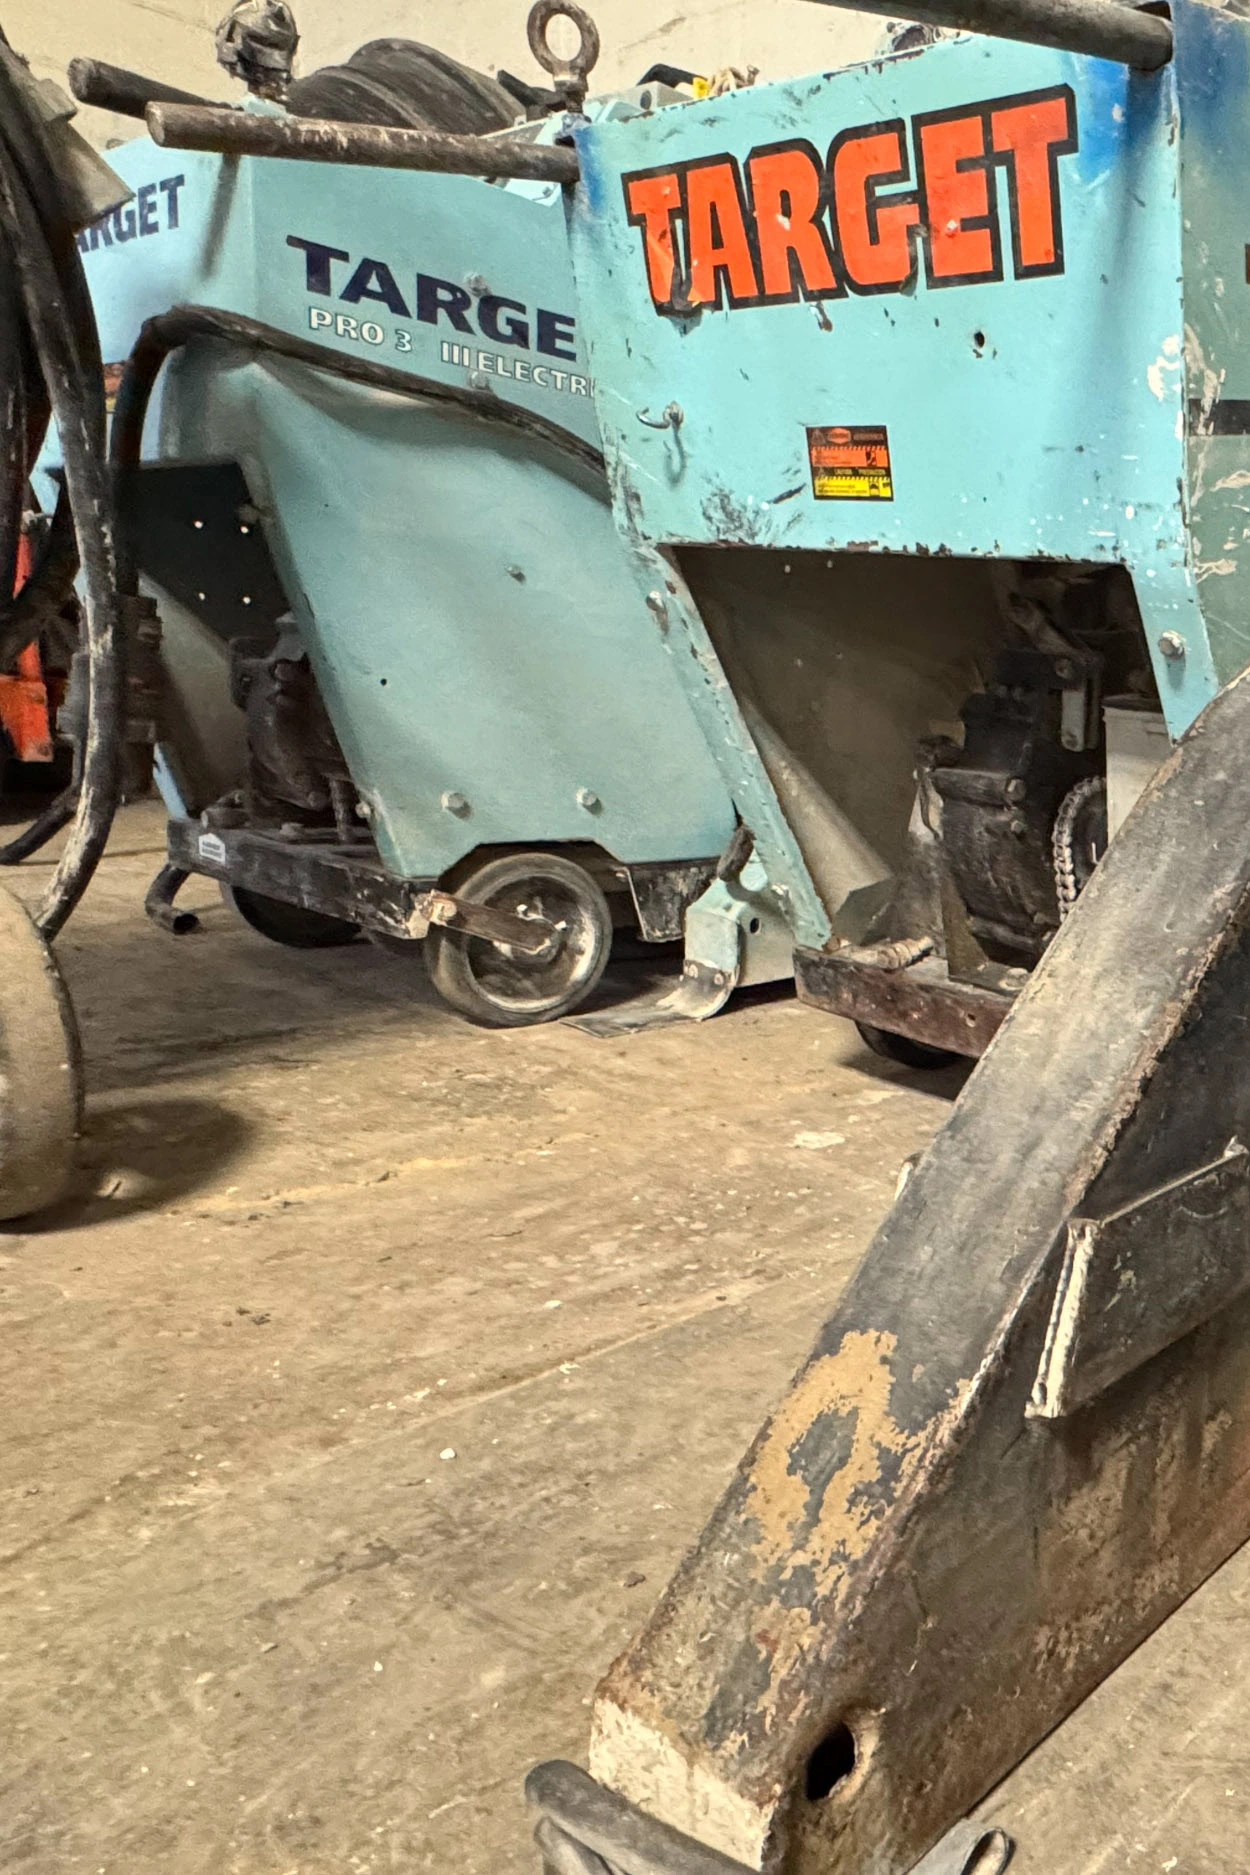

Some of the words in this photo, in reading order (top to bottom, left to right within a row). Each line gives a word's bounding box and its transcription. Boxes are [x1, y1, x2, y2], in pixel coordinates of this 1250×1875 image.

[621, 84, 1078, 318] TARGET
[309, 307, 385, 345] PRO
[395, 330, 413, 354] 3
